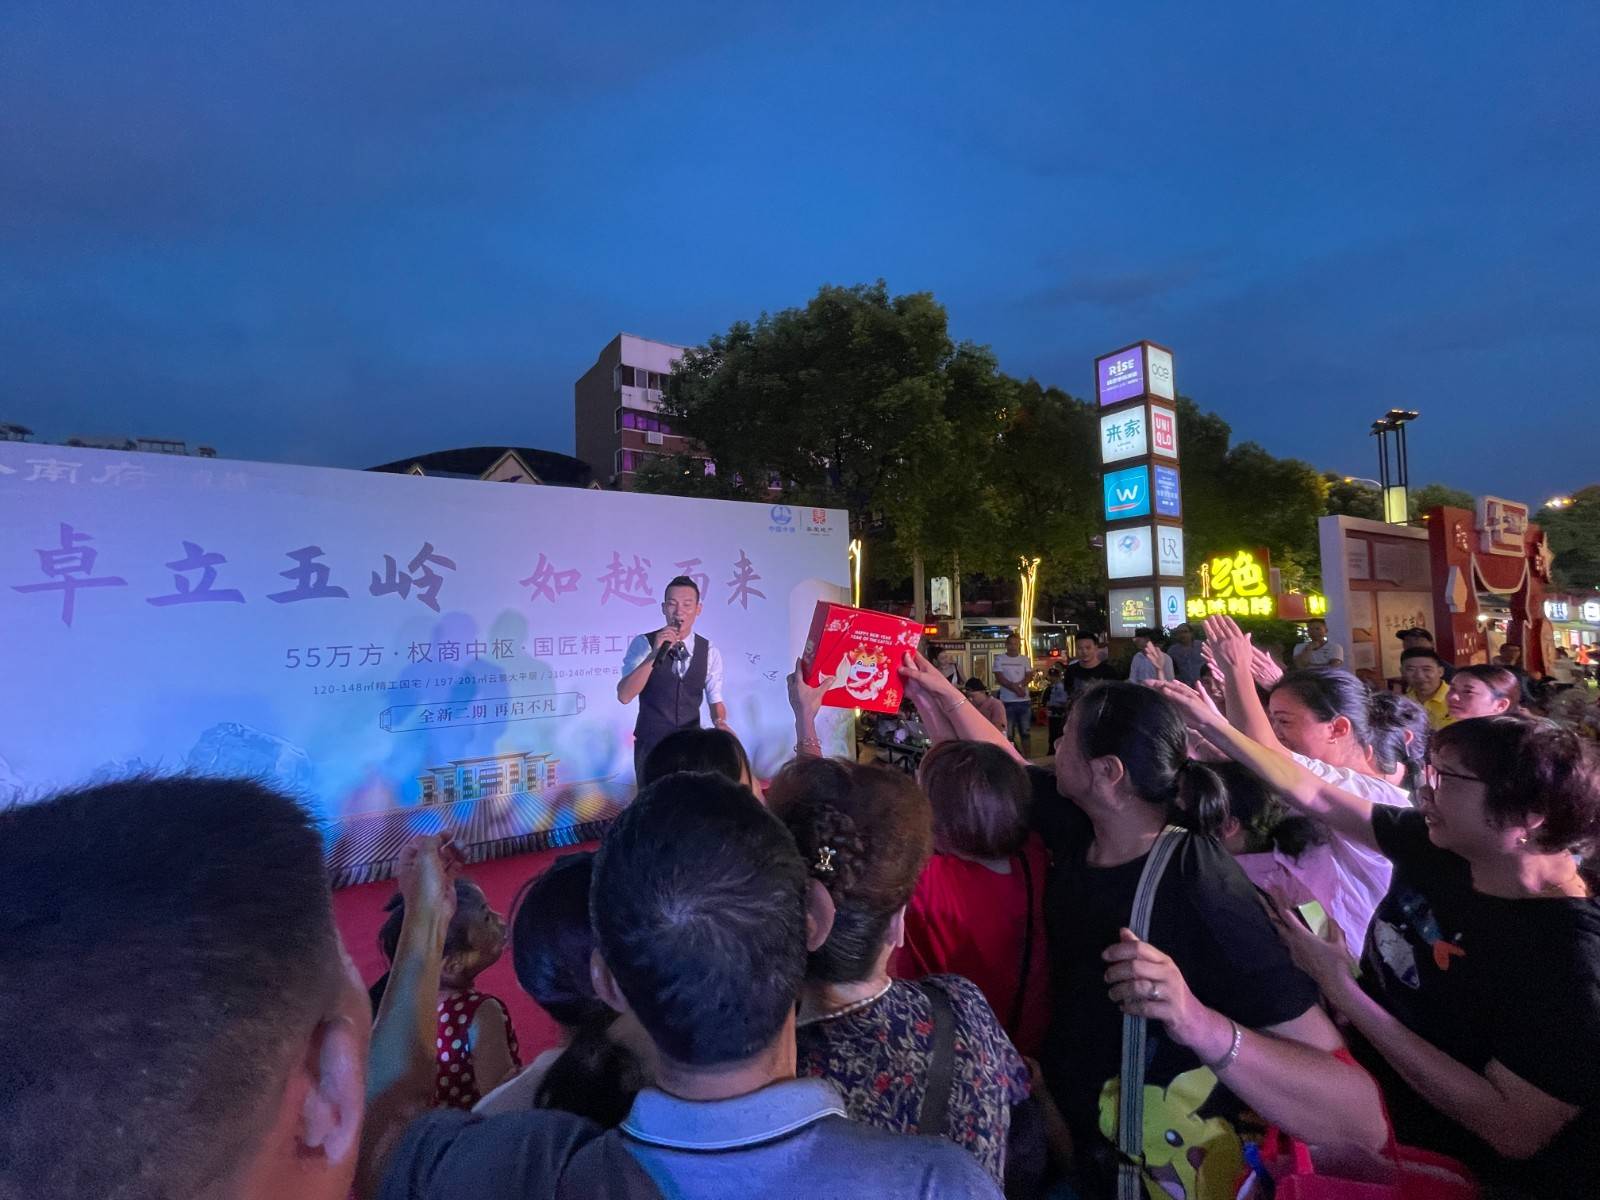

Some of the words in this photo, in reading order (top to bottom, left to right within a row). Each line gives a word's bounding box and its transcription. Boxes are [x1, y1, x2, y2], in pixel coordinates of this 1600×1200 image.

[11, 521, 457, 628] 卓立五岭
[419, 704, 488, 723] 全新二期
[495, 699, 557, 717] 再启不凡
